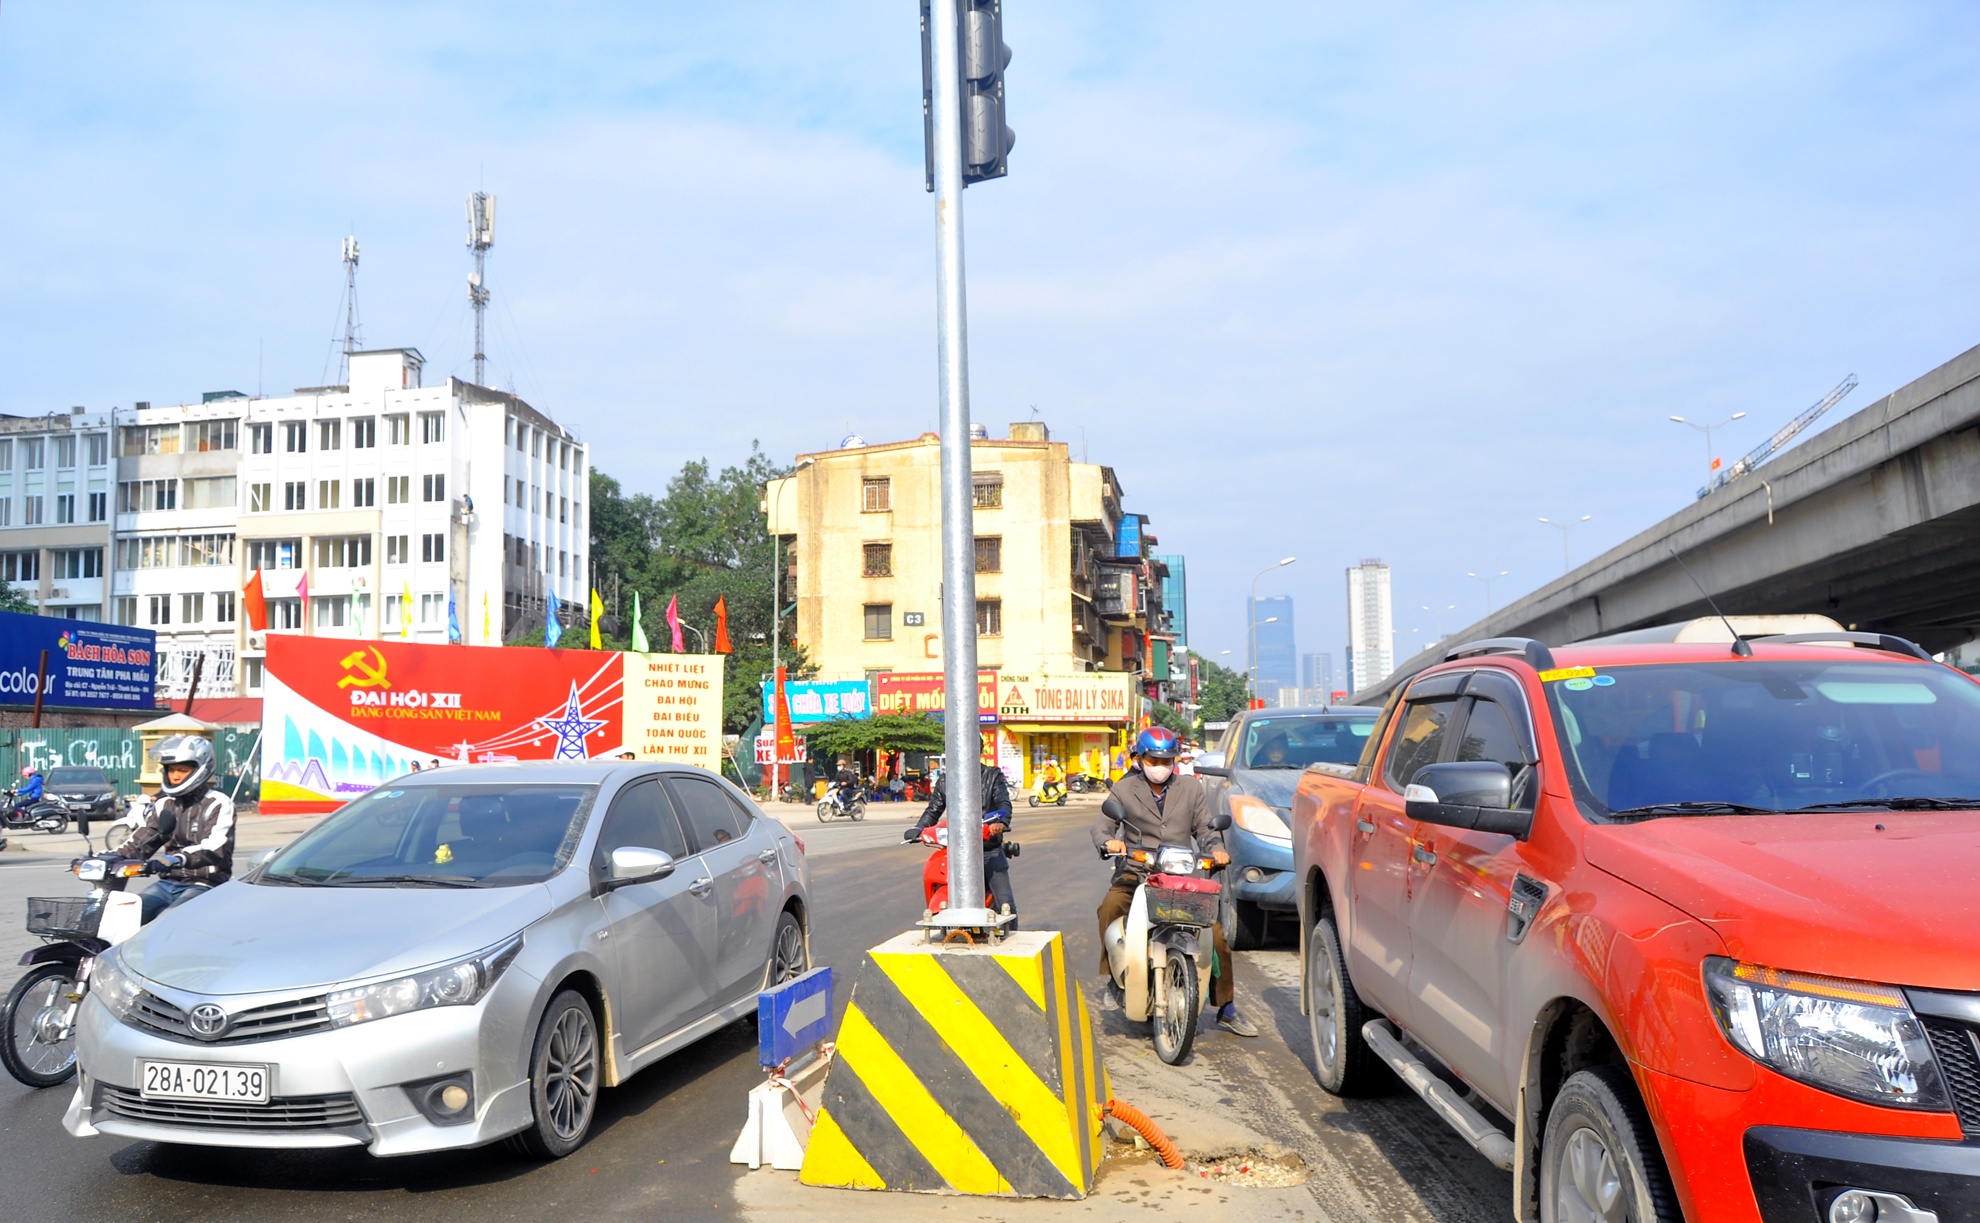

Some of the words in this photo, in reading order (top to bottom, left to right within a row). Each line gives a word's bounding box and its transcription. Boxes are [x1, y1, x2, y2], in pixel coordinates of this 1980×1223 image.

[906, 614, 922, 625] C3
[66, 667, 95, 678] TRUNG
[96, 666, 114, 679] TÂM
[115, 670, 131, 681] PHA
[1566, 668, 1590, 677] 025
[350, 690, 387, 708] ĐẠI
[390, 689, 428, 709] HỘI
[430, 692, 462, 708] XII
[792, 689, 823, 714] CHỮA
[823, 693, 840, 714] XE
[841, 688, 866, 713] MÁY
[880, 690, 912, 710] DIỆT
[916, 687, 945, 709] MỐI
[979, 686, 995, 708] ỖI
[1035, 684, 1062, 710] TỔNG
[1065, 689, 1083, 714] ĐẠI
[1086, 685, 1098, 710] LÝ
[1101, 689, 1125, 710] SIKA
[350, 705, 384, 718] ĐẢNG
[385, 707, 419, 720] CỘNG
[419, 707, 443, 719] SẢN
[445, 709, 473, 721] VIỆT
[474, 710, 501, 721] NAM
[1001, 706, 1029, 714] DTH
[68, 740, 136, 769] Chanh
[693, 746, 707, 755] XII
[756, 750, 771, 762] XE
[147, 1066, 263, 1097] 28A-021.39
